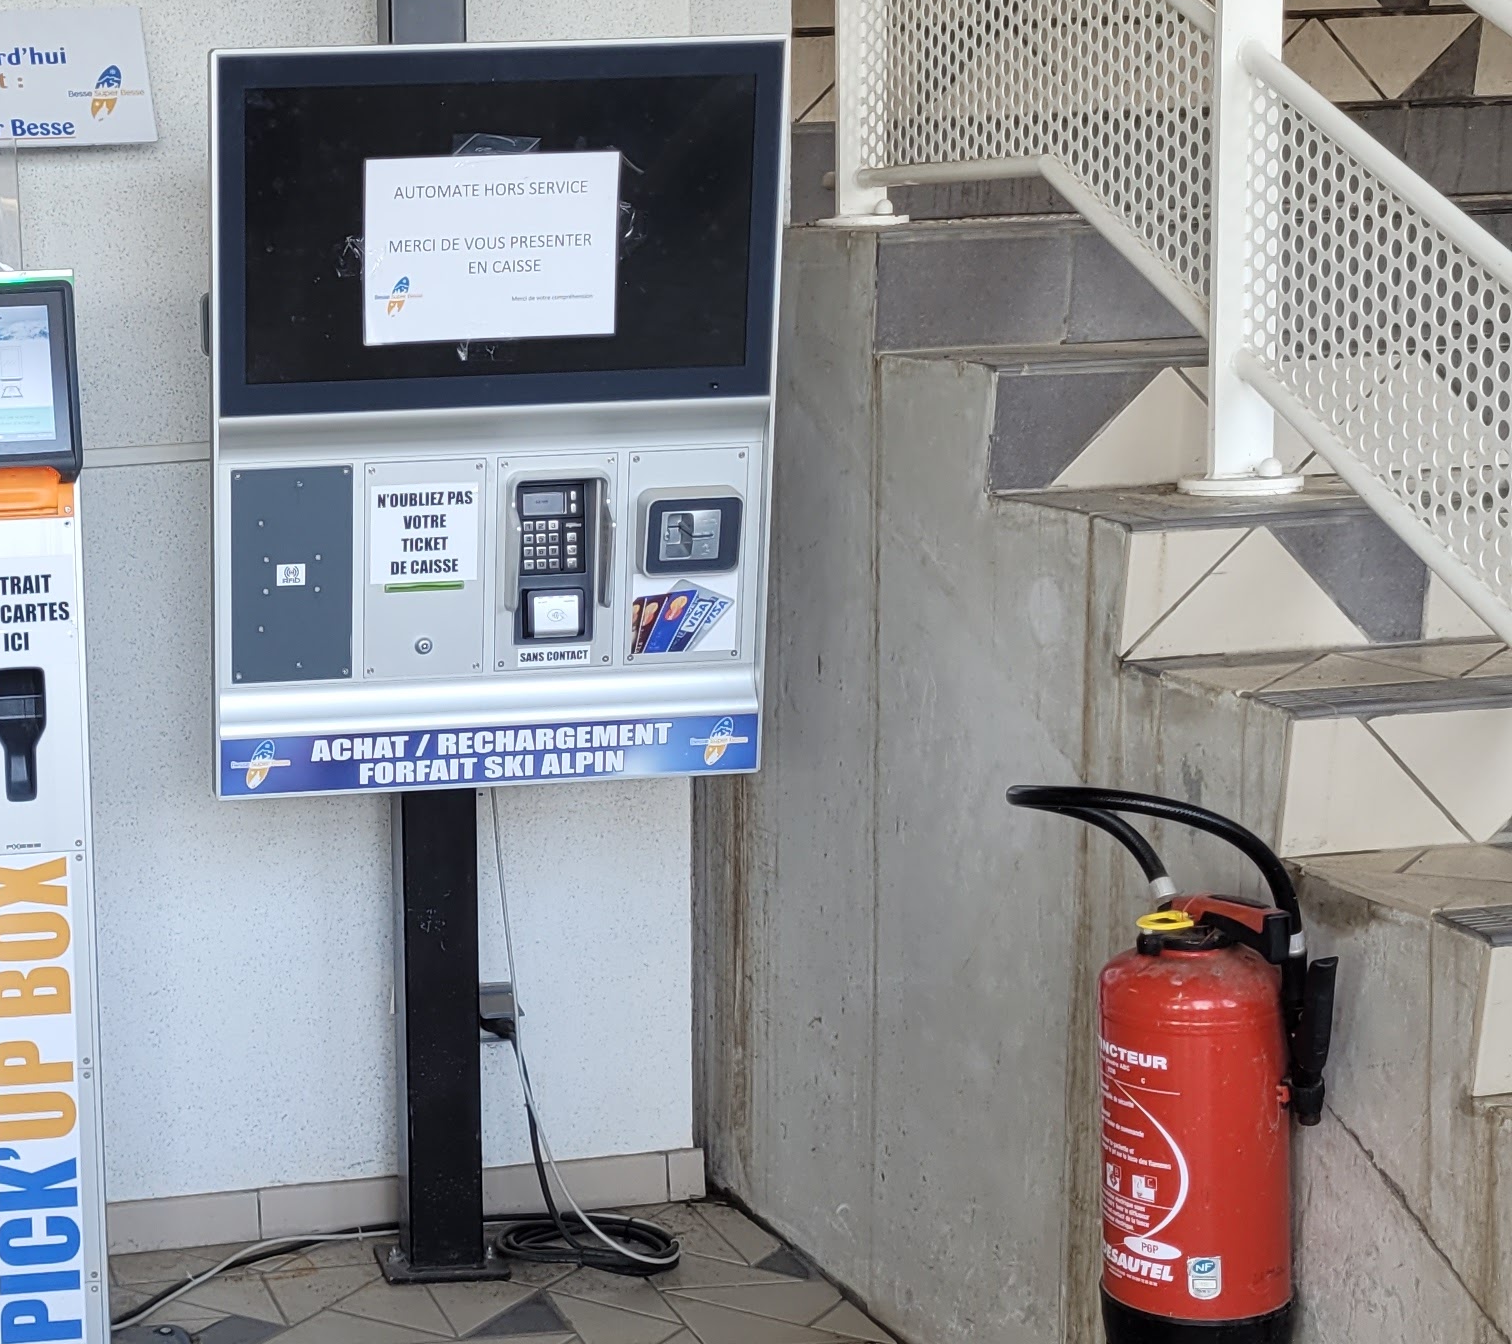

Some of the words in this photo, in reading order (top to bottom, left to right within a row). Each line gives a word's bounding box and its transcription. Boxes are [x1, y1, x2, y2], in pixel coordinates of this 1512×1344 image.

[11, 118, 76, 137] Besse
[394, 183, 480, 200] AUTOMATE
[484, 182, 525, 197] HORS
[528, 180, 589, 195] SERVICE
[389, 239, 436, 254] MERCI
[441, 237, 460, 252] DE
[464, 236, 506, 251] VOUS
[510, 233, 593, 249] PRESENTER
[468, 261, 488, 274] EN
[492, 259, 542, 274] CAISSE
[377, 491, 444, 509] N'OUBLIEZ
[447, 490, 474, 506] PAS
[403, 513, 447, 530] VOTRE
[400, 535, 449, 553] TICKET
[389, 560, 407, 576] DE
[410, 558, 459, 575] CAISSE
[0, 601, 70, 624] CARTES
[686, 602, 710, 629] VISA
[703, 598, 729, 625] VISA
[3, 631, 30, 652] ICI
[519, 651, 545, 663] SANS
[546, 649, 589, 662] CONTACT
[310, 735, 410, 763] ACHAT
[437, 722, 674, 756] RECHARGEMENT
[358, 757, 478, 786] FORFAIT
[483, 754, 535, 779] SKI
[540, 749, 626, 776] ALPIN
[1097, 1035, 1168, 1071] INCTEUR
[1195, 1262, 1214, 1272] NF
